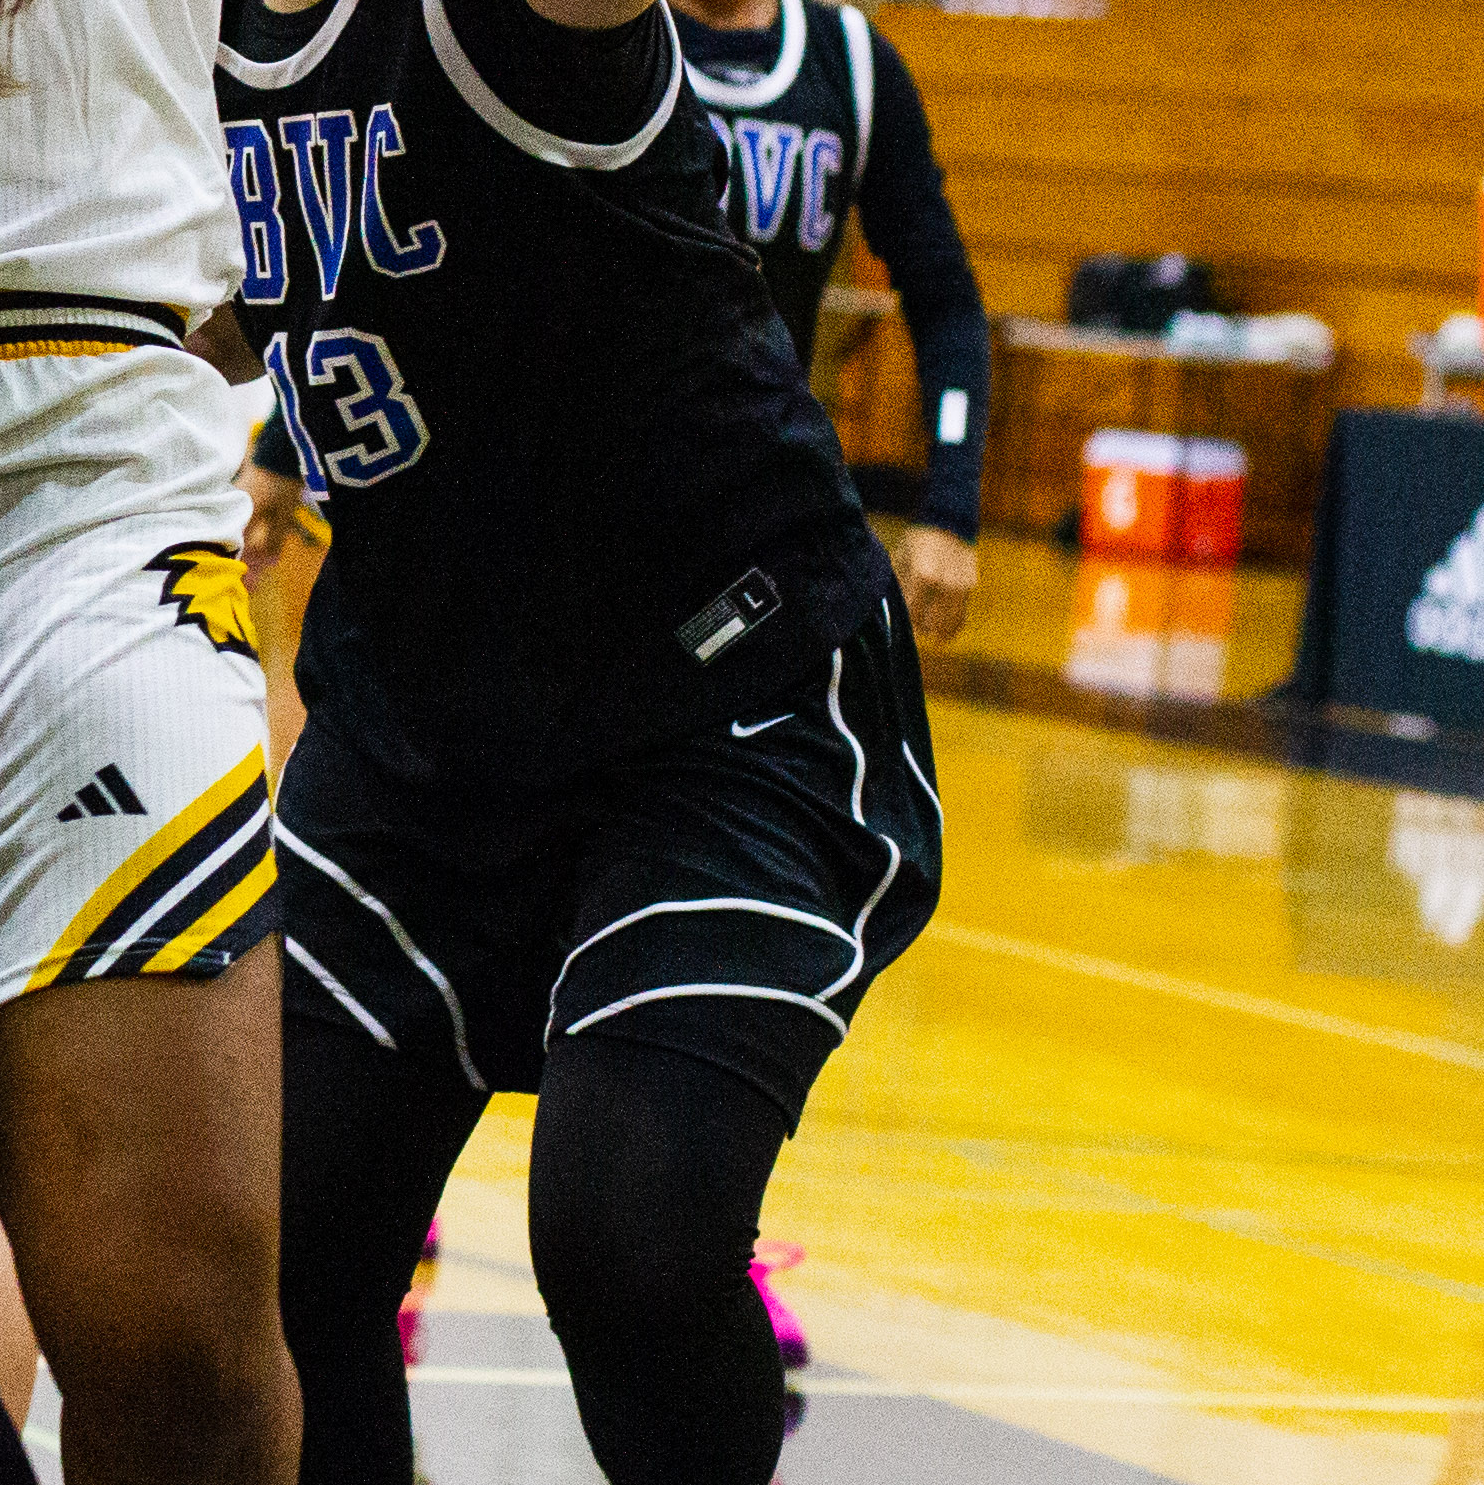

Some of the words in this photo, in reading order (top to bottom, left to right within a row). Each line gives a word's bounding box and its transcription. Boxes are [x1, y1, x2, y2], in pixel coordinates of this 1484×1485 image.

[220, 102, 447, 305] BVC
[708, 112, 844, 251] VC
[263, 327, 430, 501] 13
